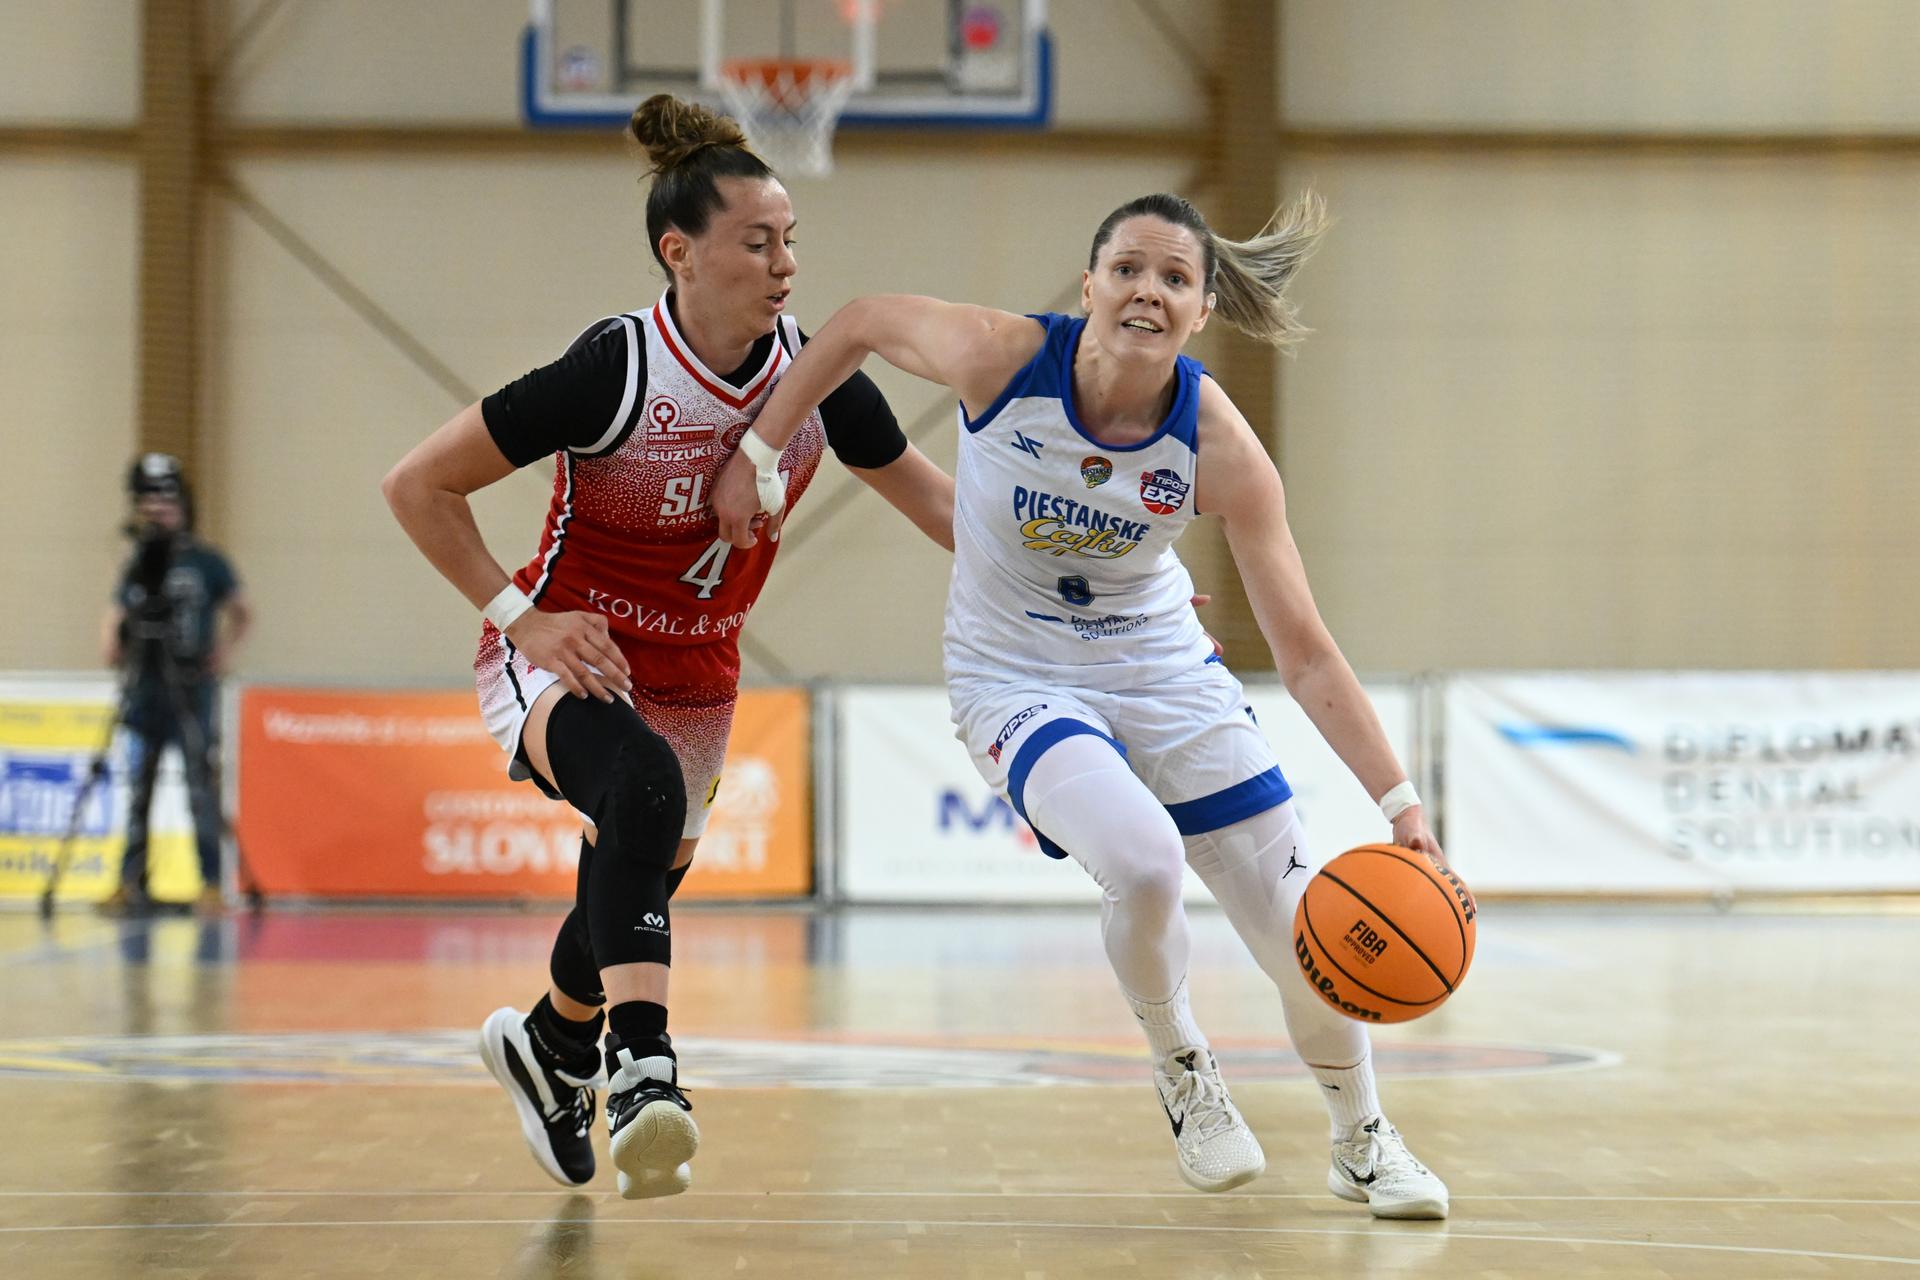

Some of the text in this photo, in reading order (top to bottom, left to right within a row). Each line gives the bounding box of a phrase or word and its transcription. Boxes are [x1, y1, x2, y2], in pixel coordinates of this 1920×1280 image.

[647, 433, 681, 441] OMEGA
[647, 445, 712, 462] SUZUKI
[1143, 485, 1184, 508] EXZ
[1155, 475, 1188, 492] TIPOS
[679, 537, 733, 600] 4
[690, 614, 710, 636] &
[997, 704, 1043, 744] TIPOS
[1661, 724, 1920, 764] DIPLOMA
[1343, 934, 1376, 965] APPROVED
[1350, 919, 1388, 957] FIBA
[1295, 930, 1382, 1021] Wilson
